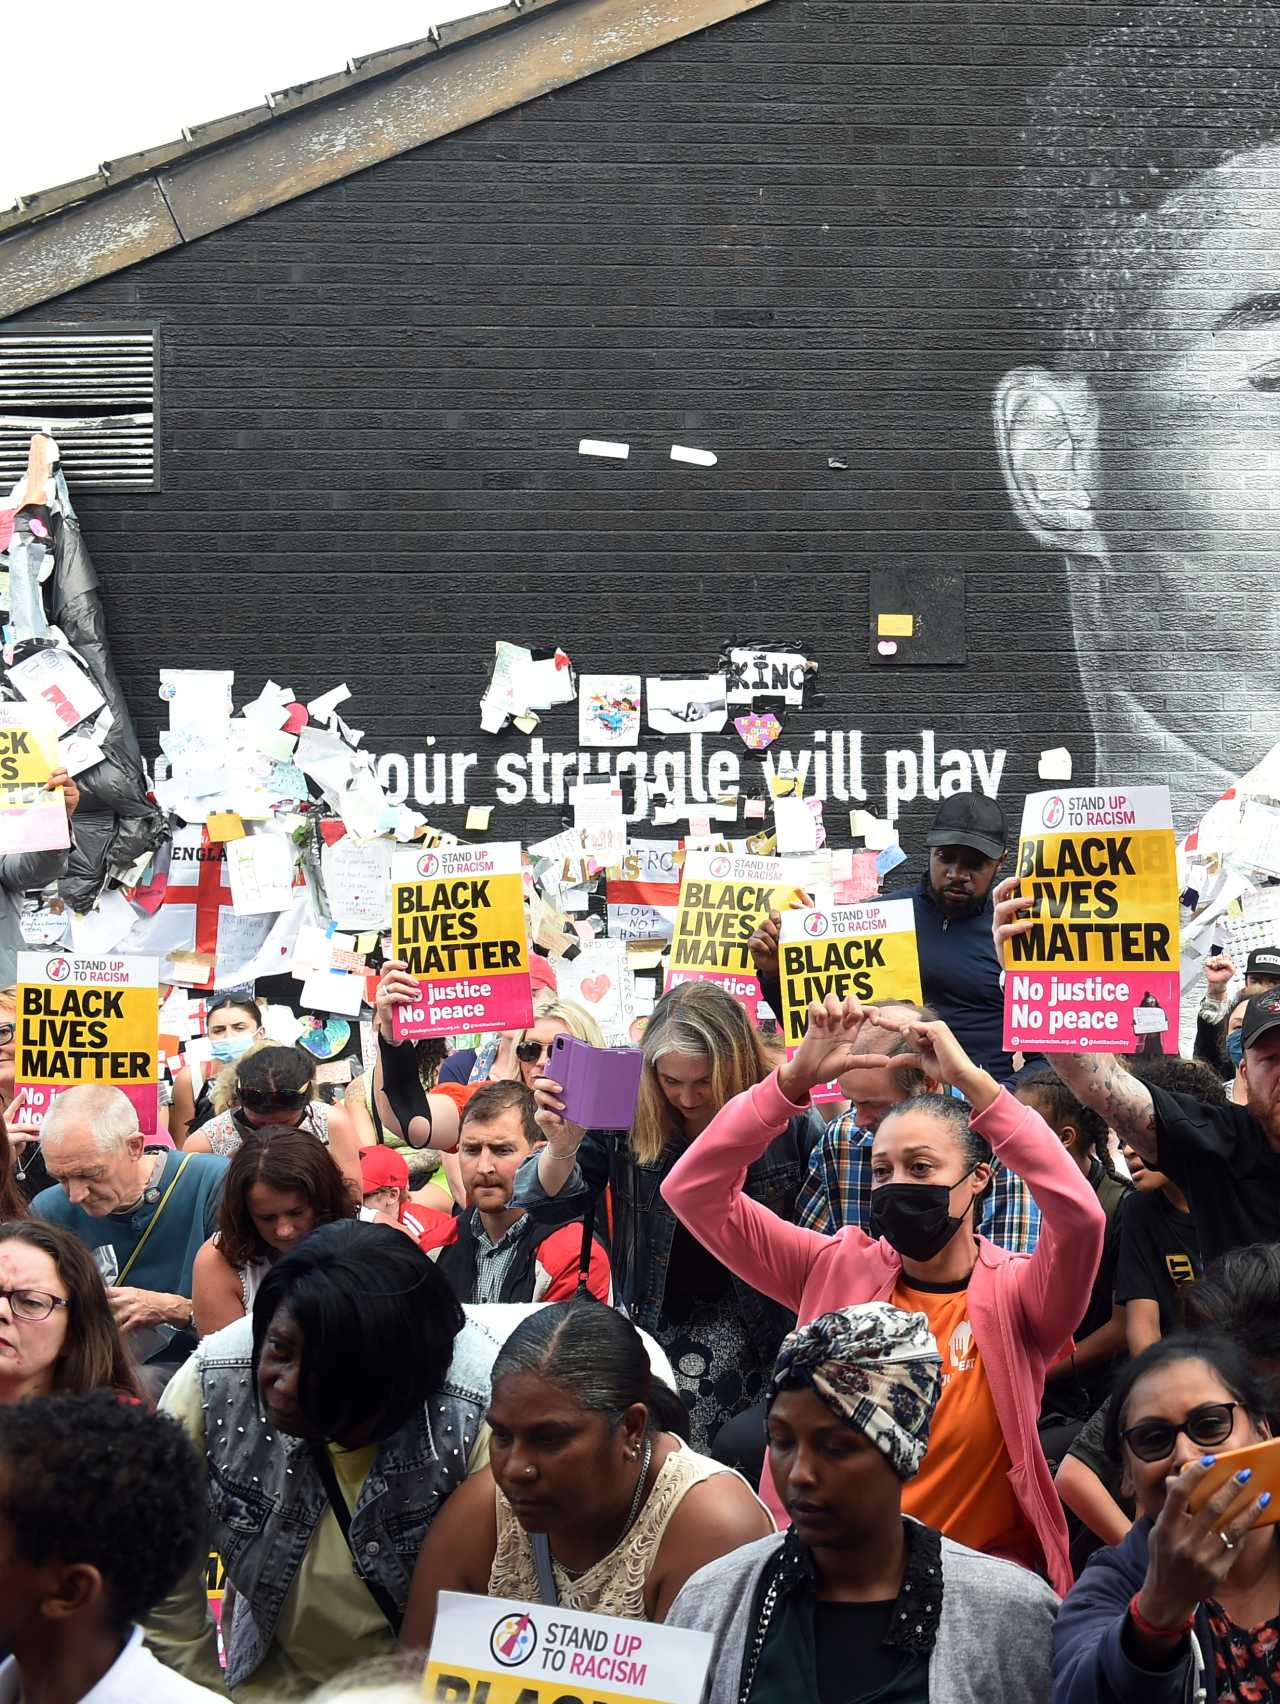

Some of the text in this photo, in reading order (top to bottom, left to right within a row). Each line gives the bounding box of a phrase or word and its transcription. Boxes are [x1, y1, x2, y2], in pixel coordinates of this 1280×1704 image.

[727, 660, 806, 692] KING
[374, 750, 478, 805] our
[496, 732, 740, 818] struggle
[762, 730, 867, 801] will
[885, 730, 1007, 820] play
[1068, 795, 1128, 811] STAND UP
[1068, 811, 1136, 826] TO RACISM
[171, 847, 228, 862] ENGLA
[441, 850, 489, 864] STAND UP
[442, 861, 494, 875] TO RACISM
[733, 859, 780, 870] STAND UP
[1018, 836, 1136, 879] BLACK
[733, 868, 783, 881] TO RACISM
[397, 879, 492, 915] BLACK
[684, 882, 776, 913] BLACK
[1013, 879, 1119, 920] LIVES
[397, 911, 479, 945] LIVES
[679, 910, 757, 941] LIVES
[831, 908, 880, 923] STAND UP
[832, 918, 888, 934] TO RACISM
[397, 940, 522, 975] MATTER
[674, 940, 758, 971] MATT
[784, 938, 886, 976] BLACK
[1011, 922, 1171, 962] MATTER
[73, 960, 124, 972] STAND UP
[74, 971, 129, 983] TO RACISM
[23, 987, 125, 1019] BLACK
[427, 980, 492, 1006] justice
[787, 971, 874, 1008] LIVES
[1012, 975, 1130, 1007] No justice
[398, 1003, 486, 1025] No peace
[1011, 1003, 1119, 1035] No peace
[22, 1018, 109, 1049] LIVES
[21, 1049, 151, 1079] MATTER
[545, 1622, 643, 1658] STAND UP
[541, 1647, 648, 1687] TO RACISM
